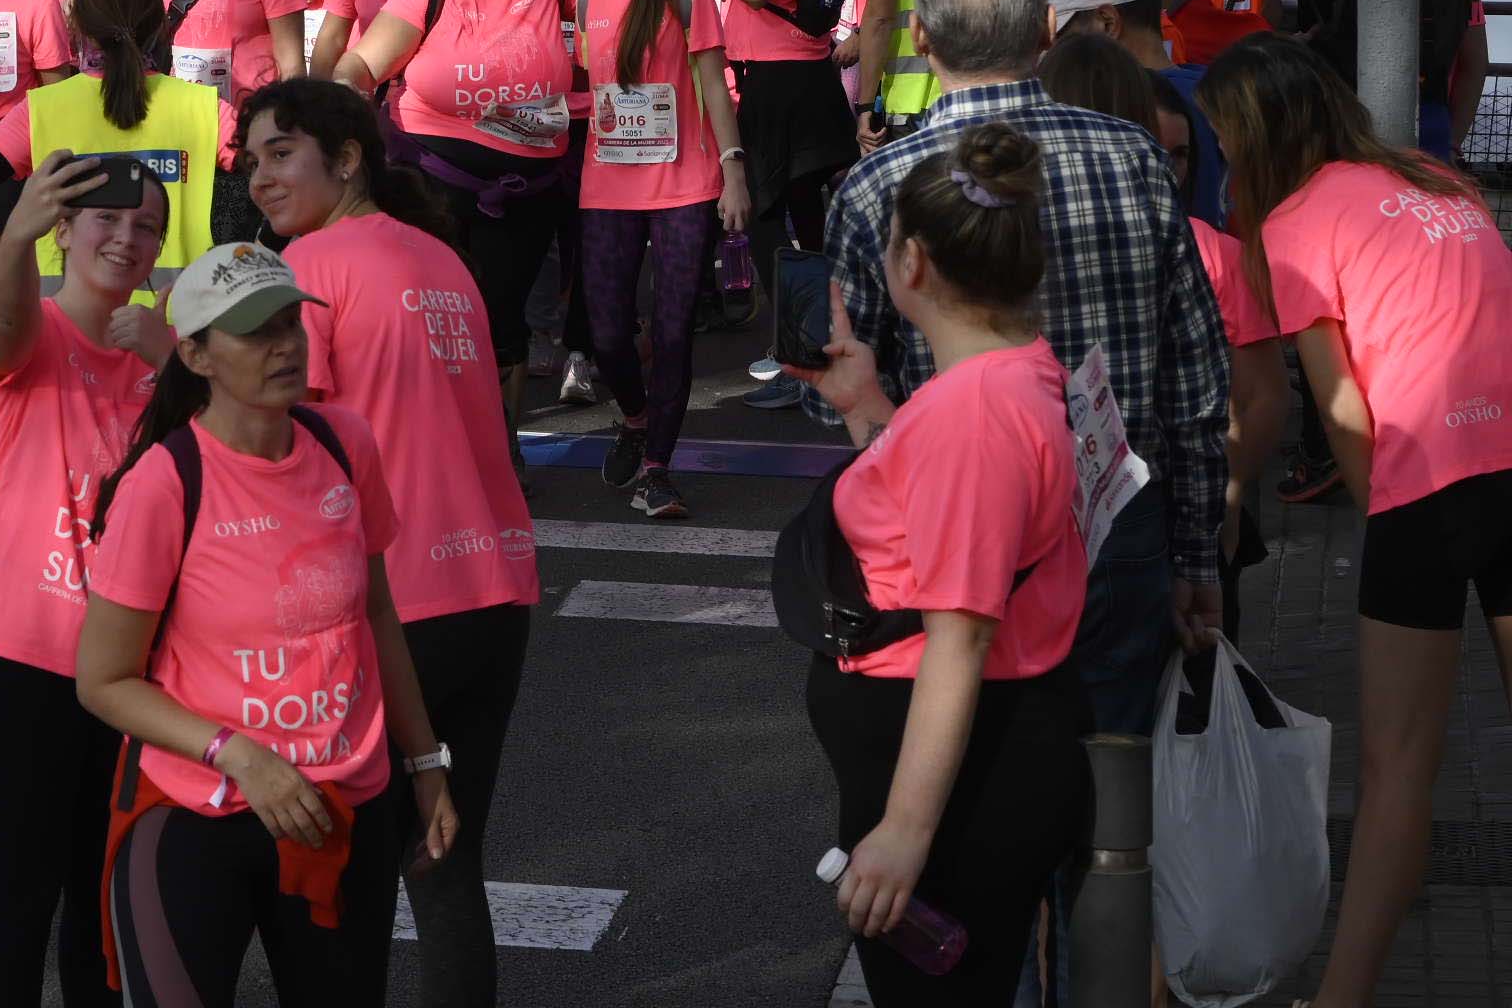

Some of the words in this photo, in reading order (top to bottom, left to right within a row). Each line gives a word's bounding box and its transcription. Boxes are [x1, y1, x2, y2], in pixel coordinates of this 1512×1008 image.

[455, 64, 484, 81] TU
[456, 82, 551, 106] DORSAL
[618, 115, 646, 126] 016
[622, 129, 642, 137] 15051
[1411, 199, 1445, 223] DE
[1423, 212, 1488, 244] MUJER
[402, 289, 473, 313] CARRERA
[425, 313, 445, 335] DE
[450, 314, 470, 336] LA
[1446, 405, 1501, 428] OYSHO
[430, 535, 495, 561] OYSHO
[233, 647, 285, 683] TU
